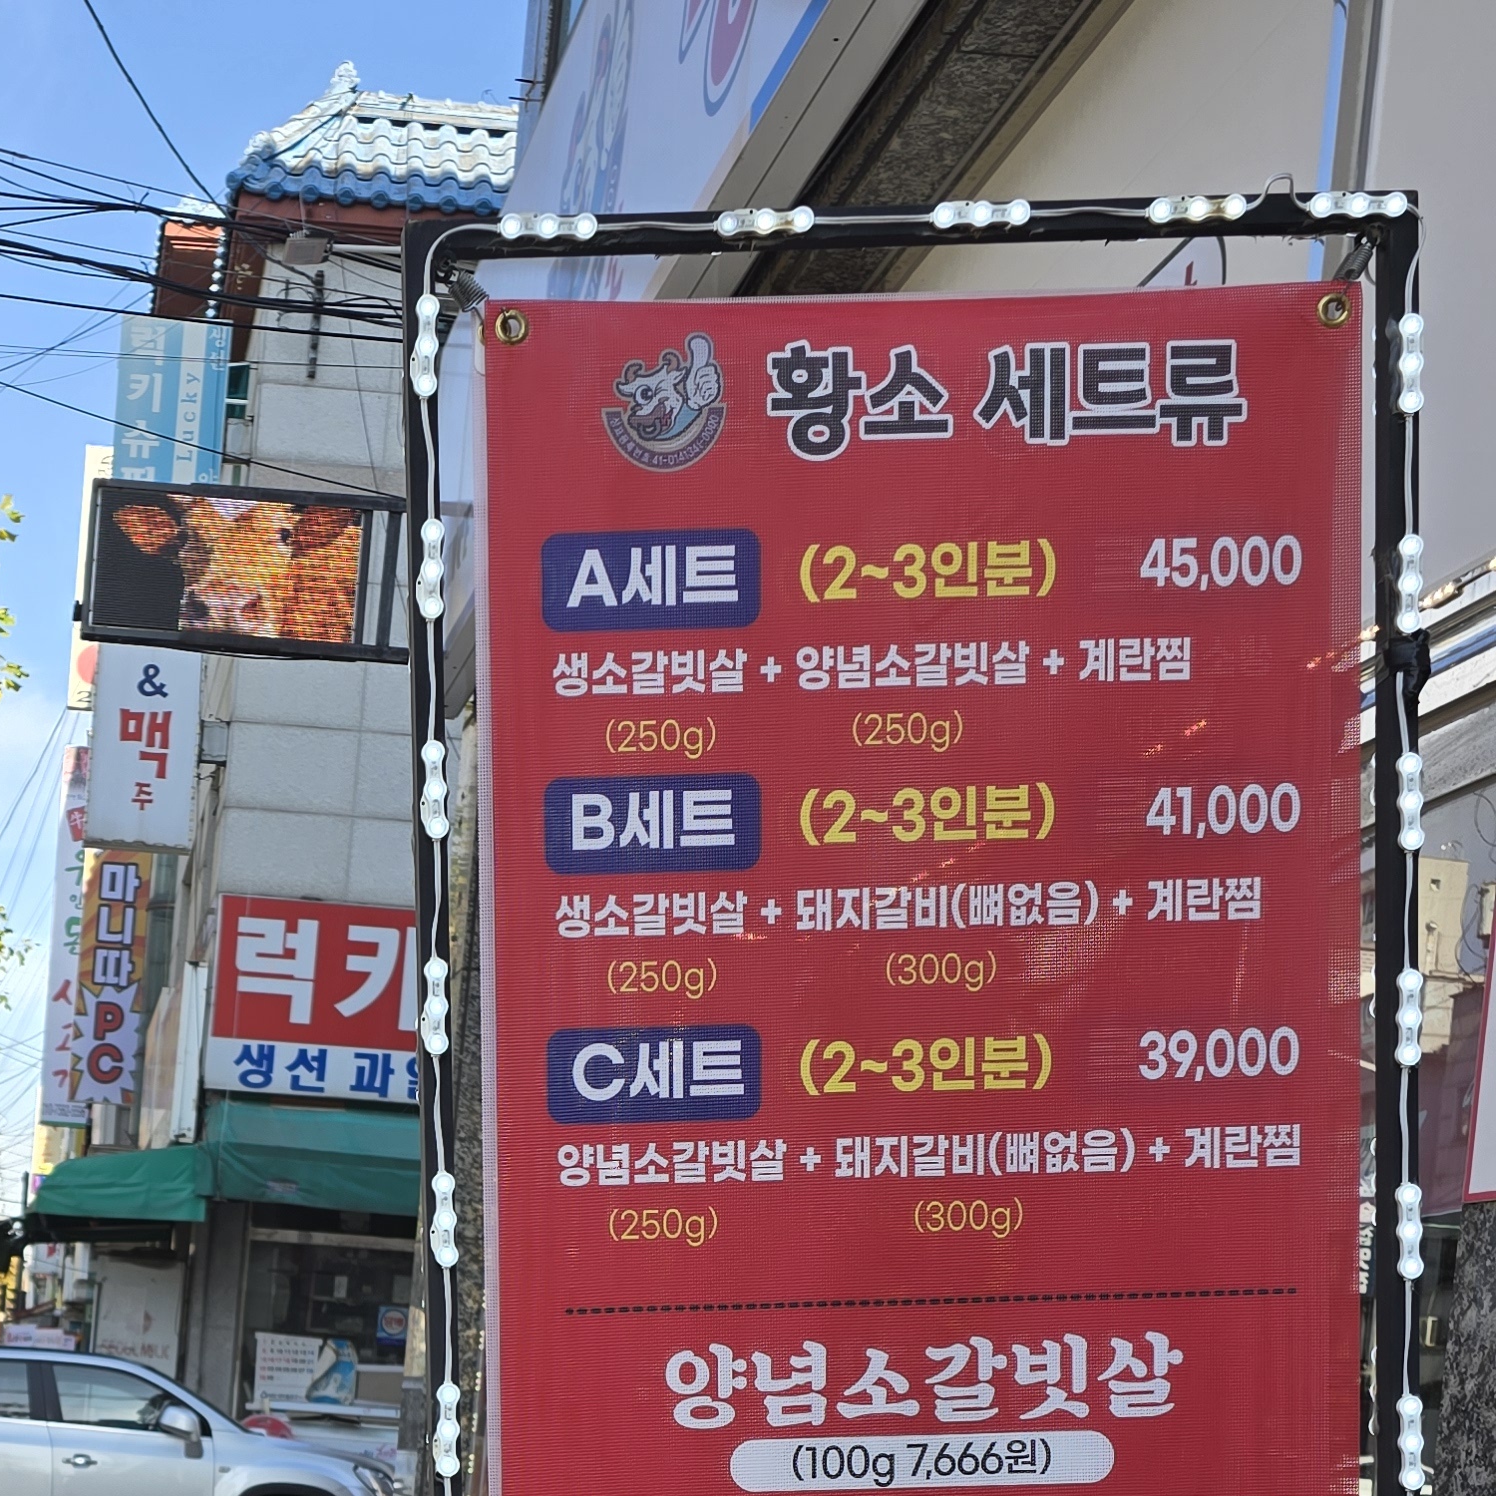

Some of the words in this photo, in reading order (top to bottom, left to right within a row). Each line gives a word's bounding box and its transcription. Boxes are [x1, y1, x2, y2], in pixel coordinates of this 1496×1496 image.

[176, 372, 200, 462] Lucky
[766, 339, 954, 462] 황소
[974, 339, 1247, 447] 세트류
[566, 548, 739, 608] A세트
[799, 538, 1057, 603] (2~3인분)
[1140, 534, 1302, 592] 45,000
[137, 664, 168, 698] &
[551, 649, 747, 697] 생소갈빗살
[796, 641, 1030, 690] 양념소갈빗살
[1078, 636, 1191, 684] 계란찜
[119, 709, 172, 811] 맥주
[605, 717, 716, 759] (250g)
[852, 710, 963, 749] (250g)
[571, 790, 736, 852] B세트
[799, 781, 1055, 847] (2~3인분)
[1145, 782, 1301, 839] 41,000
[92, 862, 141, 988] 마니따
[555, 890, 747, 939] 생소갈빗살
[796, 880, 1097, 933] 돼지갈비(뼈없음)
[1147, 876, 1262, 924] 계란찜
[236, 916, 418, 1032] 럭키
[606, 957, 718, 999] (250g)
[885, 950, 998, 990] (300g)
[87, 1001, 124, 1084] PC
[234, 1043, 328, 1093] 생선
[349, 1052, 418, 1098] 과
[573, 1040, 745, 1102] C세트
[799, 1033, 1053, 1097] (2~3인분)
[1138, 1026, 1300, 1082] 39,000
[557, 1140, 786, 1186] 양념소갈빗살
[835, 1127, 1134, 1179] 돼지갈비(뼈없음)
[1184, 1122, 1301, 1170] 계란찜
[608, 1206, 718, 1245] (250g)
[913, 1197, 1024, 1237] (300g)
[665, 1330, 1184, 1430] 양념소갈빗살
[791, 1443, 896, 1488] (100g
[906, 1437, 1052, 1482] 7,666원)
